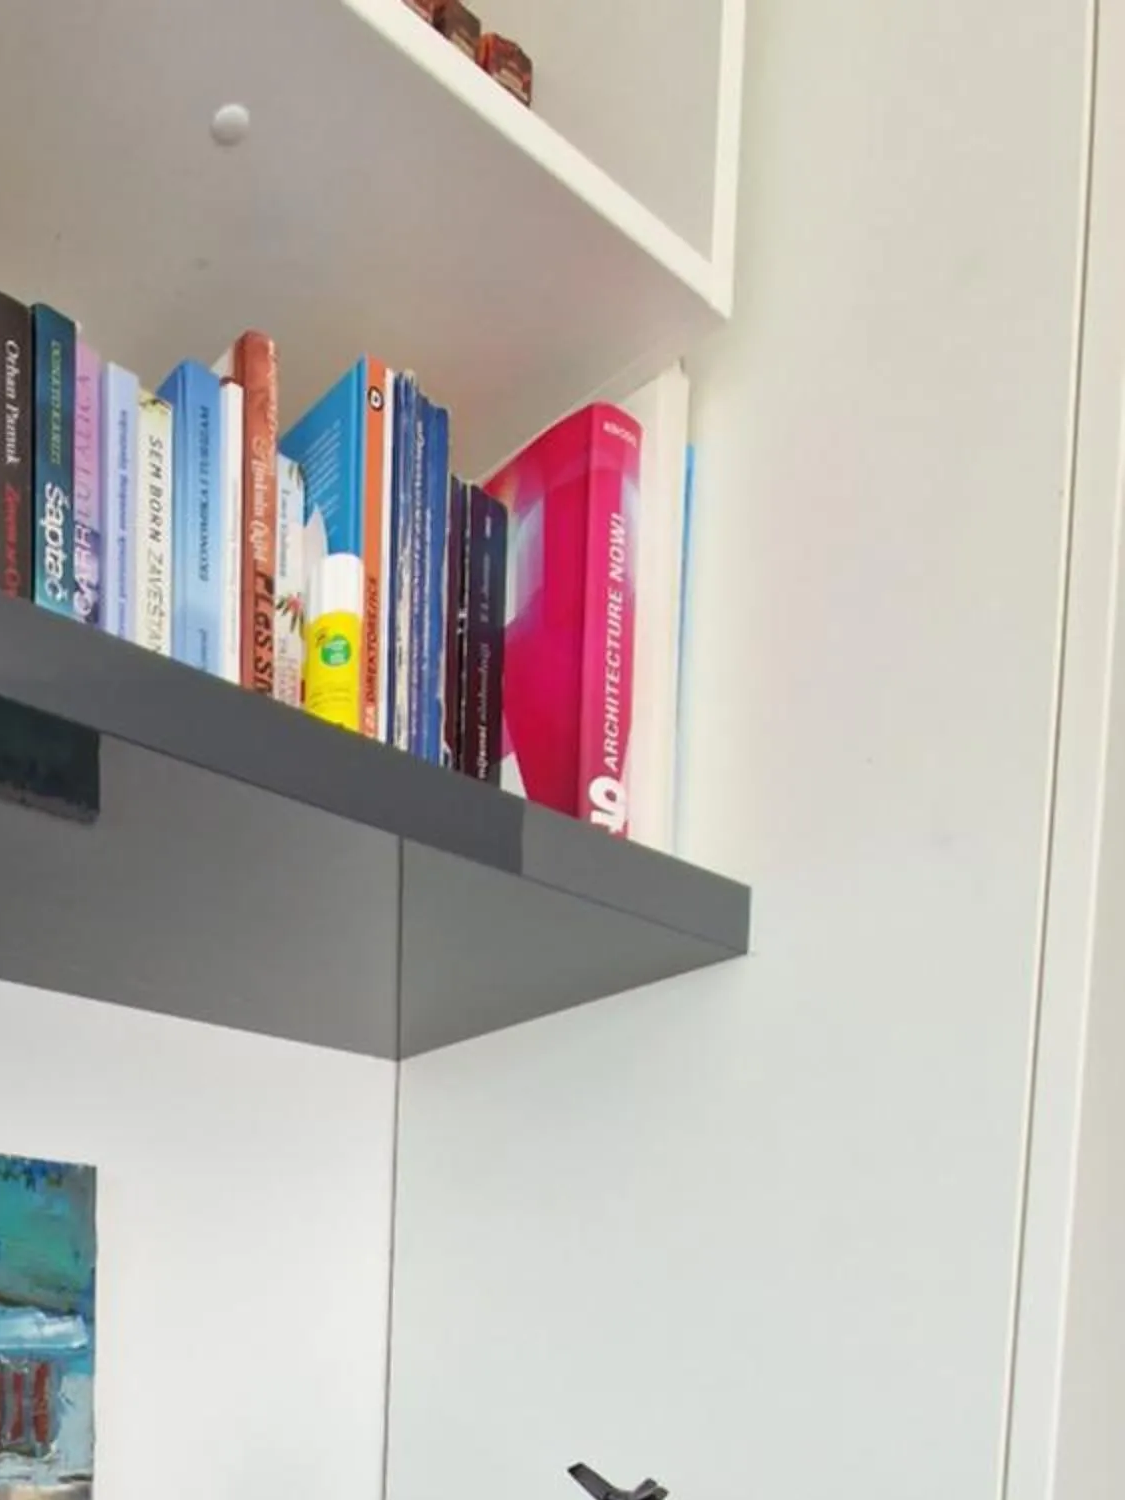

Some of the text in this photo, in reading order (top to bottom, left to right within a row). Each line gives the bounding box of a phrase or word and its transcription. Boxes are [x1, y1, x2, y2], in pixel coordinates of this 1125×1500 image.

[5, 340, 20, 399] Orhan
[5, 403, 22, 465] Pamuk
[149, 434, 164, 480] SEM
[148, 484, 164, 543] BORN
[608, 511, 627, 583] NOW!
[602, 587, 624, 773] ARCHITECTURE
